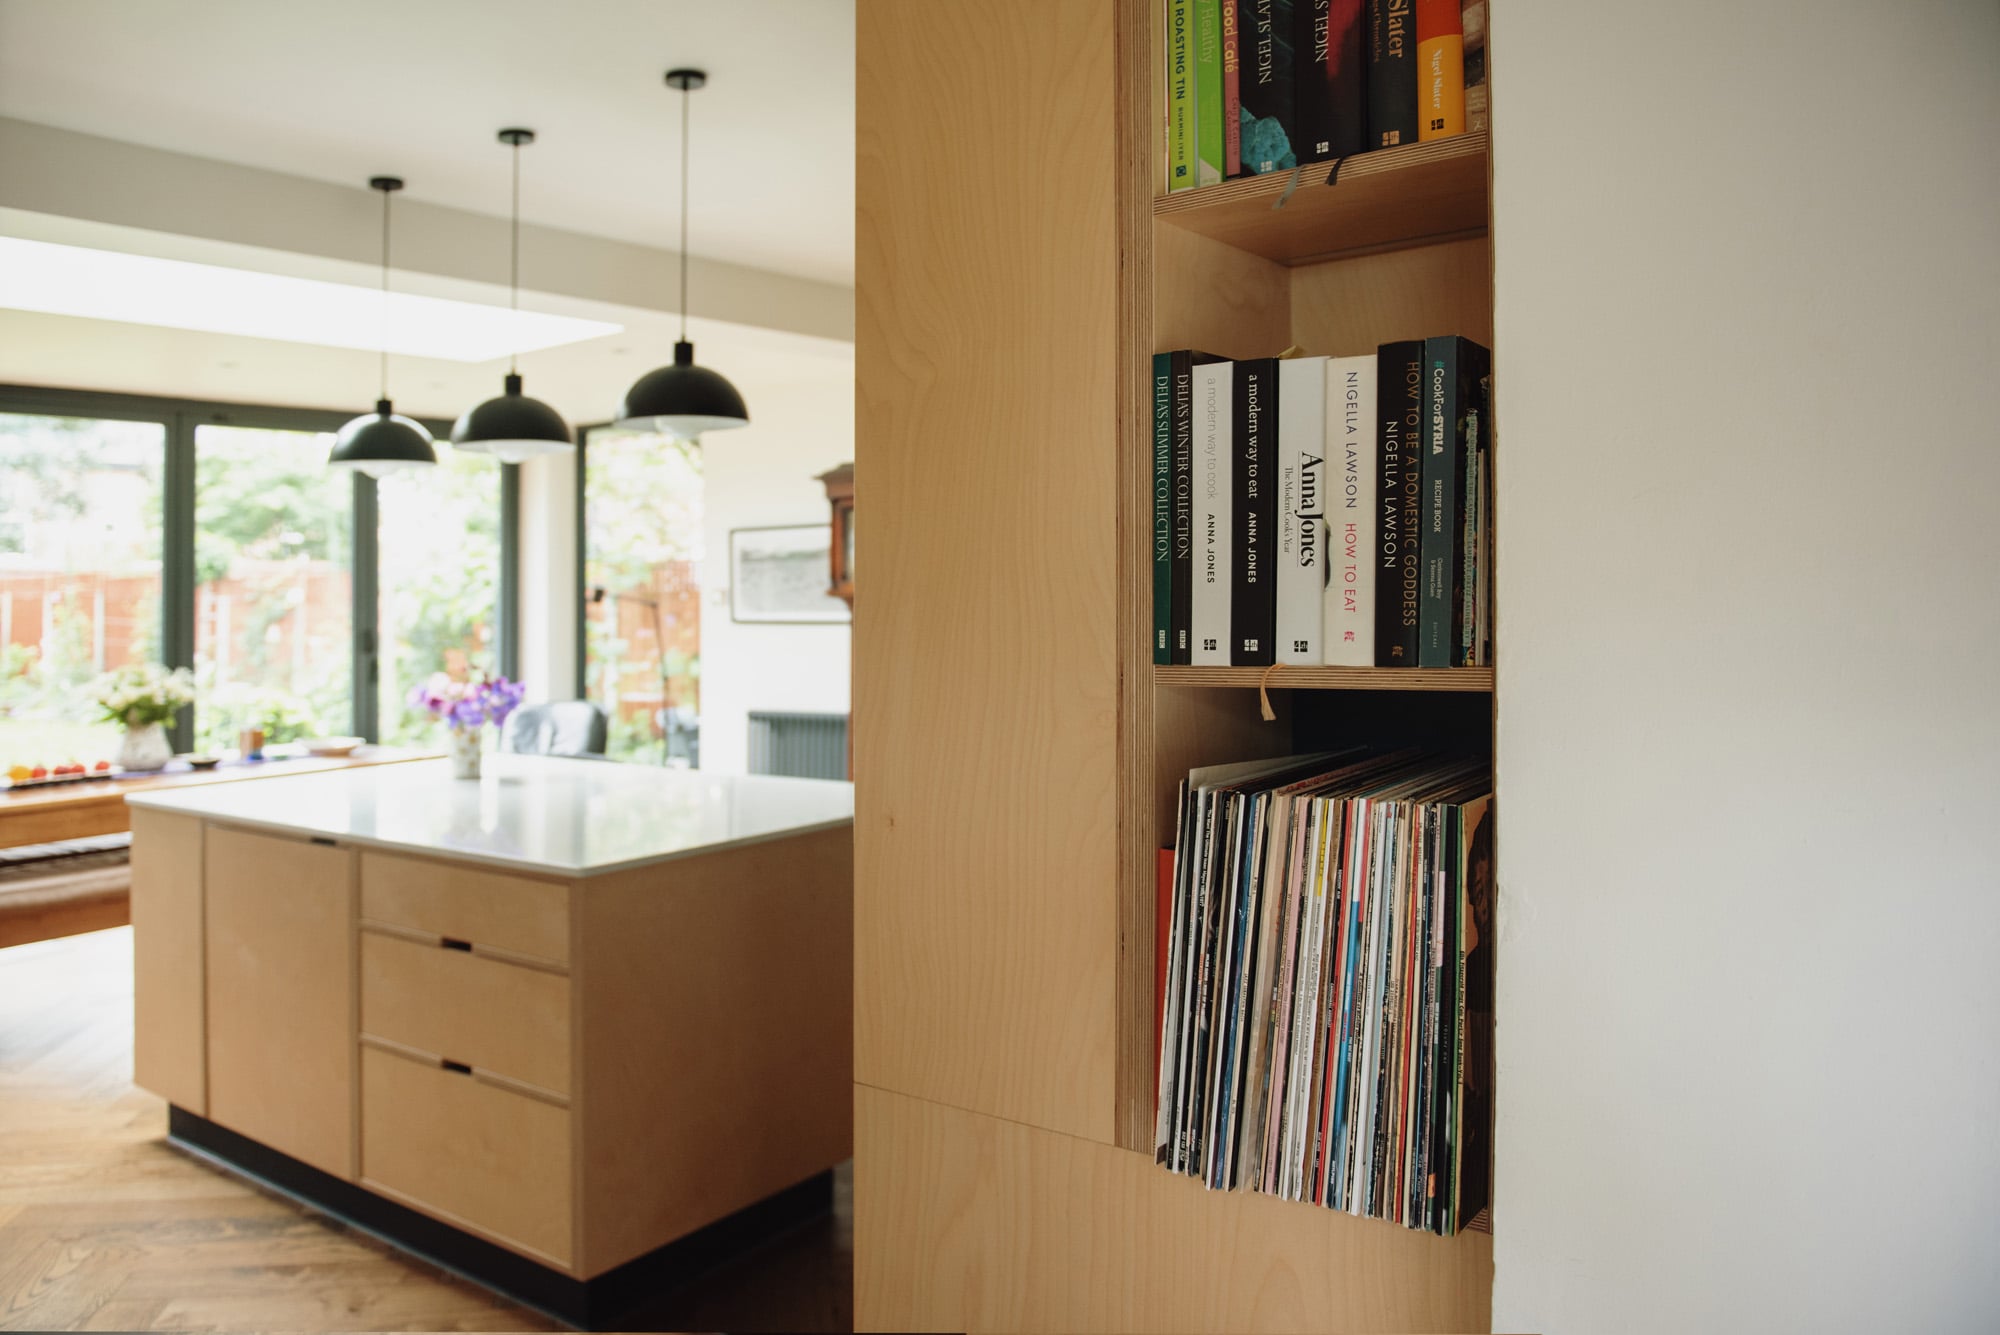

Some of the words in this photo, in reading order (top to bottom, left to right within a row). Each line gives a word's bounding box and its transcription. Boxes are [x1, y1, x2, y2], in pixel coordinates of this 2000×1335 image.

[1199, 8, 1216, 63] Healthy
[1223, 0, 1238, 36] Food
[1388, 0, 1410, 59] Slater
[1175, 8, 1185, 75] ROASTING
[1314, 12, 1329, 63] NIGEL
[1224, 41, 1238, 73] Café
[1257, 39, 1273, 86] NIGEL
[1431, 49, 1443, 75] Nigel
[1175, 80, 1186, 100] TIN
[1432, 78, 1443, 110] Slater
[1177, 374, 1189, 418] DELIA'S
[1207, 377, 1216, 385] a
[1248, 374, 1258, 382] a
[1406, 361, 1420, 400] HOW
[1156, 375, 1169, 420] DELIA'S
[1207, 387, 1221, 432] modern
[1248, 383, 1262, 434] modern
[1345, 371, 1358, 435] NIGELLA
[1405, 405, 1420, 426] TO
[1432, 359, 1445, 455] #CookForSYRIA
[1156, 421, 1168, 476] SUMMER
[1177, 420, 1189, 472] WINTER
[1204, 434, 1217, 457] way
[1244, 435, 1258, 462] way
[1384, 421, 1398, 489] NIGELLA
[1405, 432, 1419, 449] BE
[1207, 458, 1218, 471] to
[1248, 463, 1259, 478] to
[1284, 466, 1294, 480] The
[1345, 442, 1358, 509] LAWSON
[1405, 455, 1419, 466] A
[1207, 472, 1220, 500] cook
[1248, 479, 1259, 500] eat
[1284, 481, 1293, 510] Modern
[1301, 450, 1325, 510] Anna
[1433, 479, 1442, 508] RECIPE
[1156, 478, 1168, 562] COLLECTION
[1177, 474, 1189, 560] COLLECTION
[1247, 511, 1257, 545] ANNA
[1284, 511, 1294, 537] Cook's
[1404, 472, 1419, 548] DOMESTIC
[1433, 509, 1442, 533] BOOK
[1207, 513, 1216, 545] ANNA
[1283, 537, 1293, 554] Year
[1294, 509, 1324, 568] Jones
[1344, 523, 1357, 559] HOW
[1384, 497, 1398, 568] LAWSON
[1207, 548, 1216, 584] JONES
[1247, 547, 1257, 584] JONES
[1344, 564, 1357, 583] TO
[1344, 588, 1356, 613] EAT
[1402, 554, 1417, 626] GODDESS
